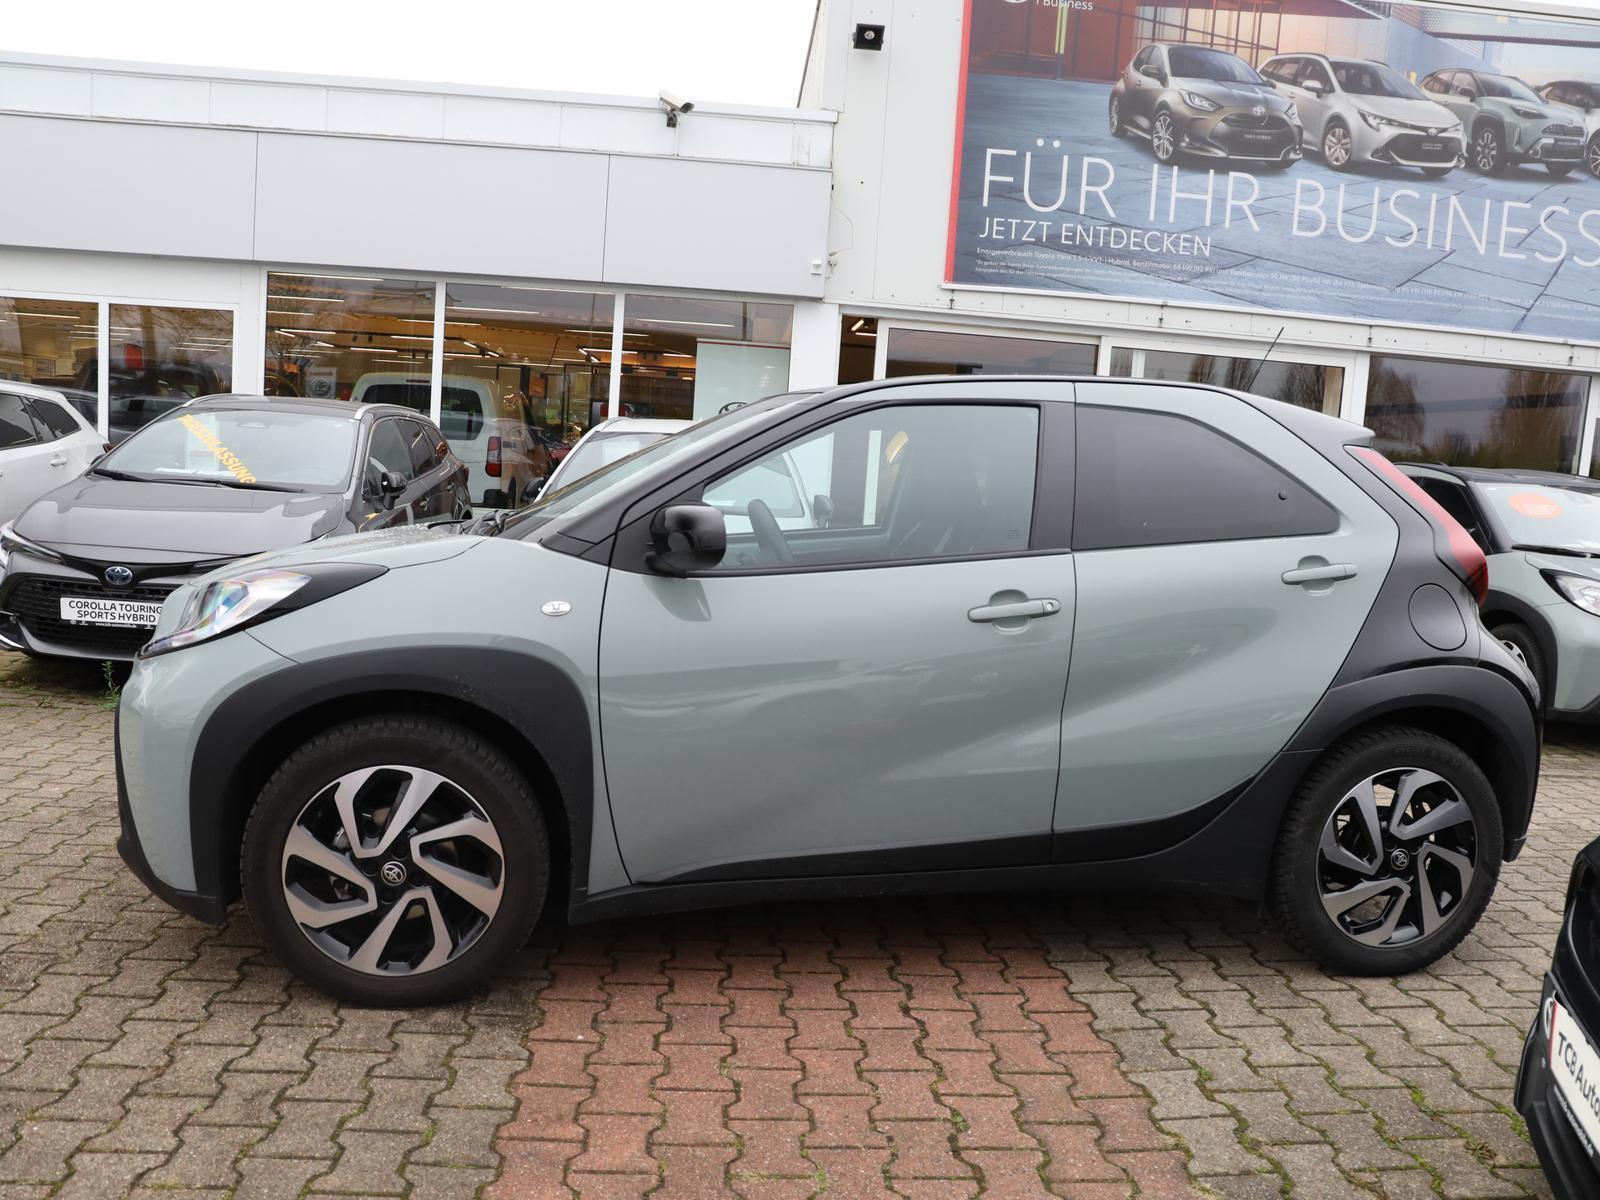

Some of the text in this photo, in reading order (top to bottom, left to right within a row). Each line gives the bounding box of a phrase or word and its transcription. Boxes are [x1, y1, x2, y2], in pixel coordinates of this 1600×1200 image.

[1043, 0, 1094, 11] Business
[982, 138, 1600, 268] FÜR IHR BUSINESS
[979, 216, 1212, 257] JETZT ENTDECKEN
[976, 247, 1033, 259] Energieverbrauch
[68, 600, 117, 611] COROLLA
[77, 610, 156, 623] SPORTS HYBRID
[1558, 1031, 1600, 1125] TCB Auto
